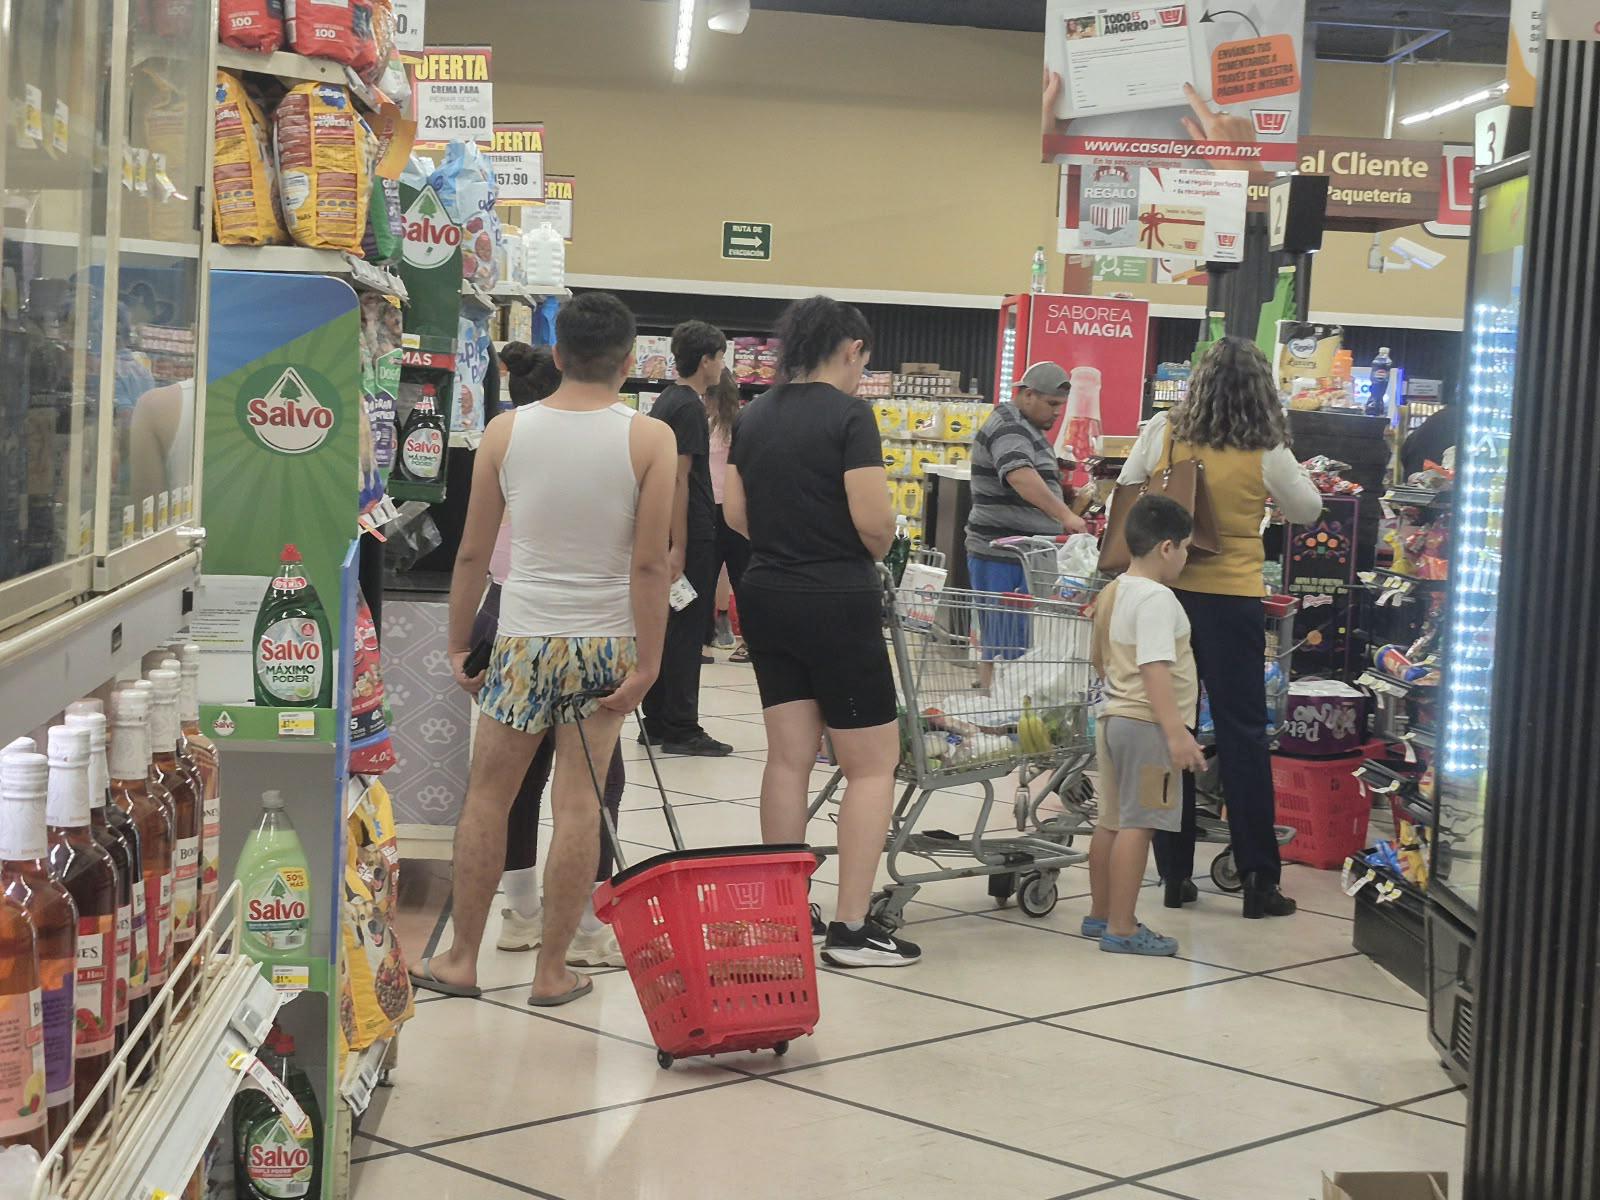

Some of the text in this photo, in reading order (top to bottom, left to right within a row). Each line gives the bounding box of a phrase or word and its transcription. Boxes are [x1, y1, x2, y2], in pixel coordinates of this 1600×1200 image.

[231, 16, 252, 27] 100
[1104, 13, 1130, 24] TODO
[314, 28, 336, 38] 100
[1104, 20, 1148, 34] AHORRO
[415, 55, 488, 80] OFERTA
[425, 116, 486, 128] 2x$115.00
[1084, 140, 1262, 157] www.casaley.com.mx
[1301, 150, 1429, 178] al Cliente
[1084, 188, 1137, 199] REGALO
[1248, 187, 1269, 200] qu
[1275, 196, 1283, 236] 2
[1048, 304, 1132, 322] SABOREA
[1045, 321, 1133, 338] LA MAGIA
[250, 400, 331, 429] Salvo
[407, 439, 440, 454] Salvo
[262, 639, 320, 660] Salvo
[266, 663, 315, 675] MÁXIMO
[272, 675, 309, 683] PODER
[249, 899, 305, 920] Salvo
[251, 1145, 308, 1166] Salvo
